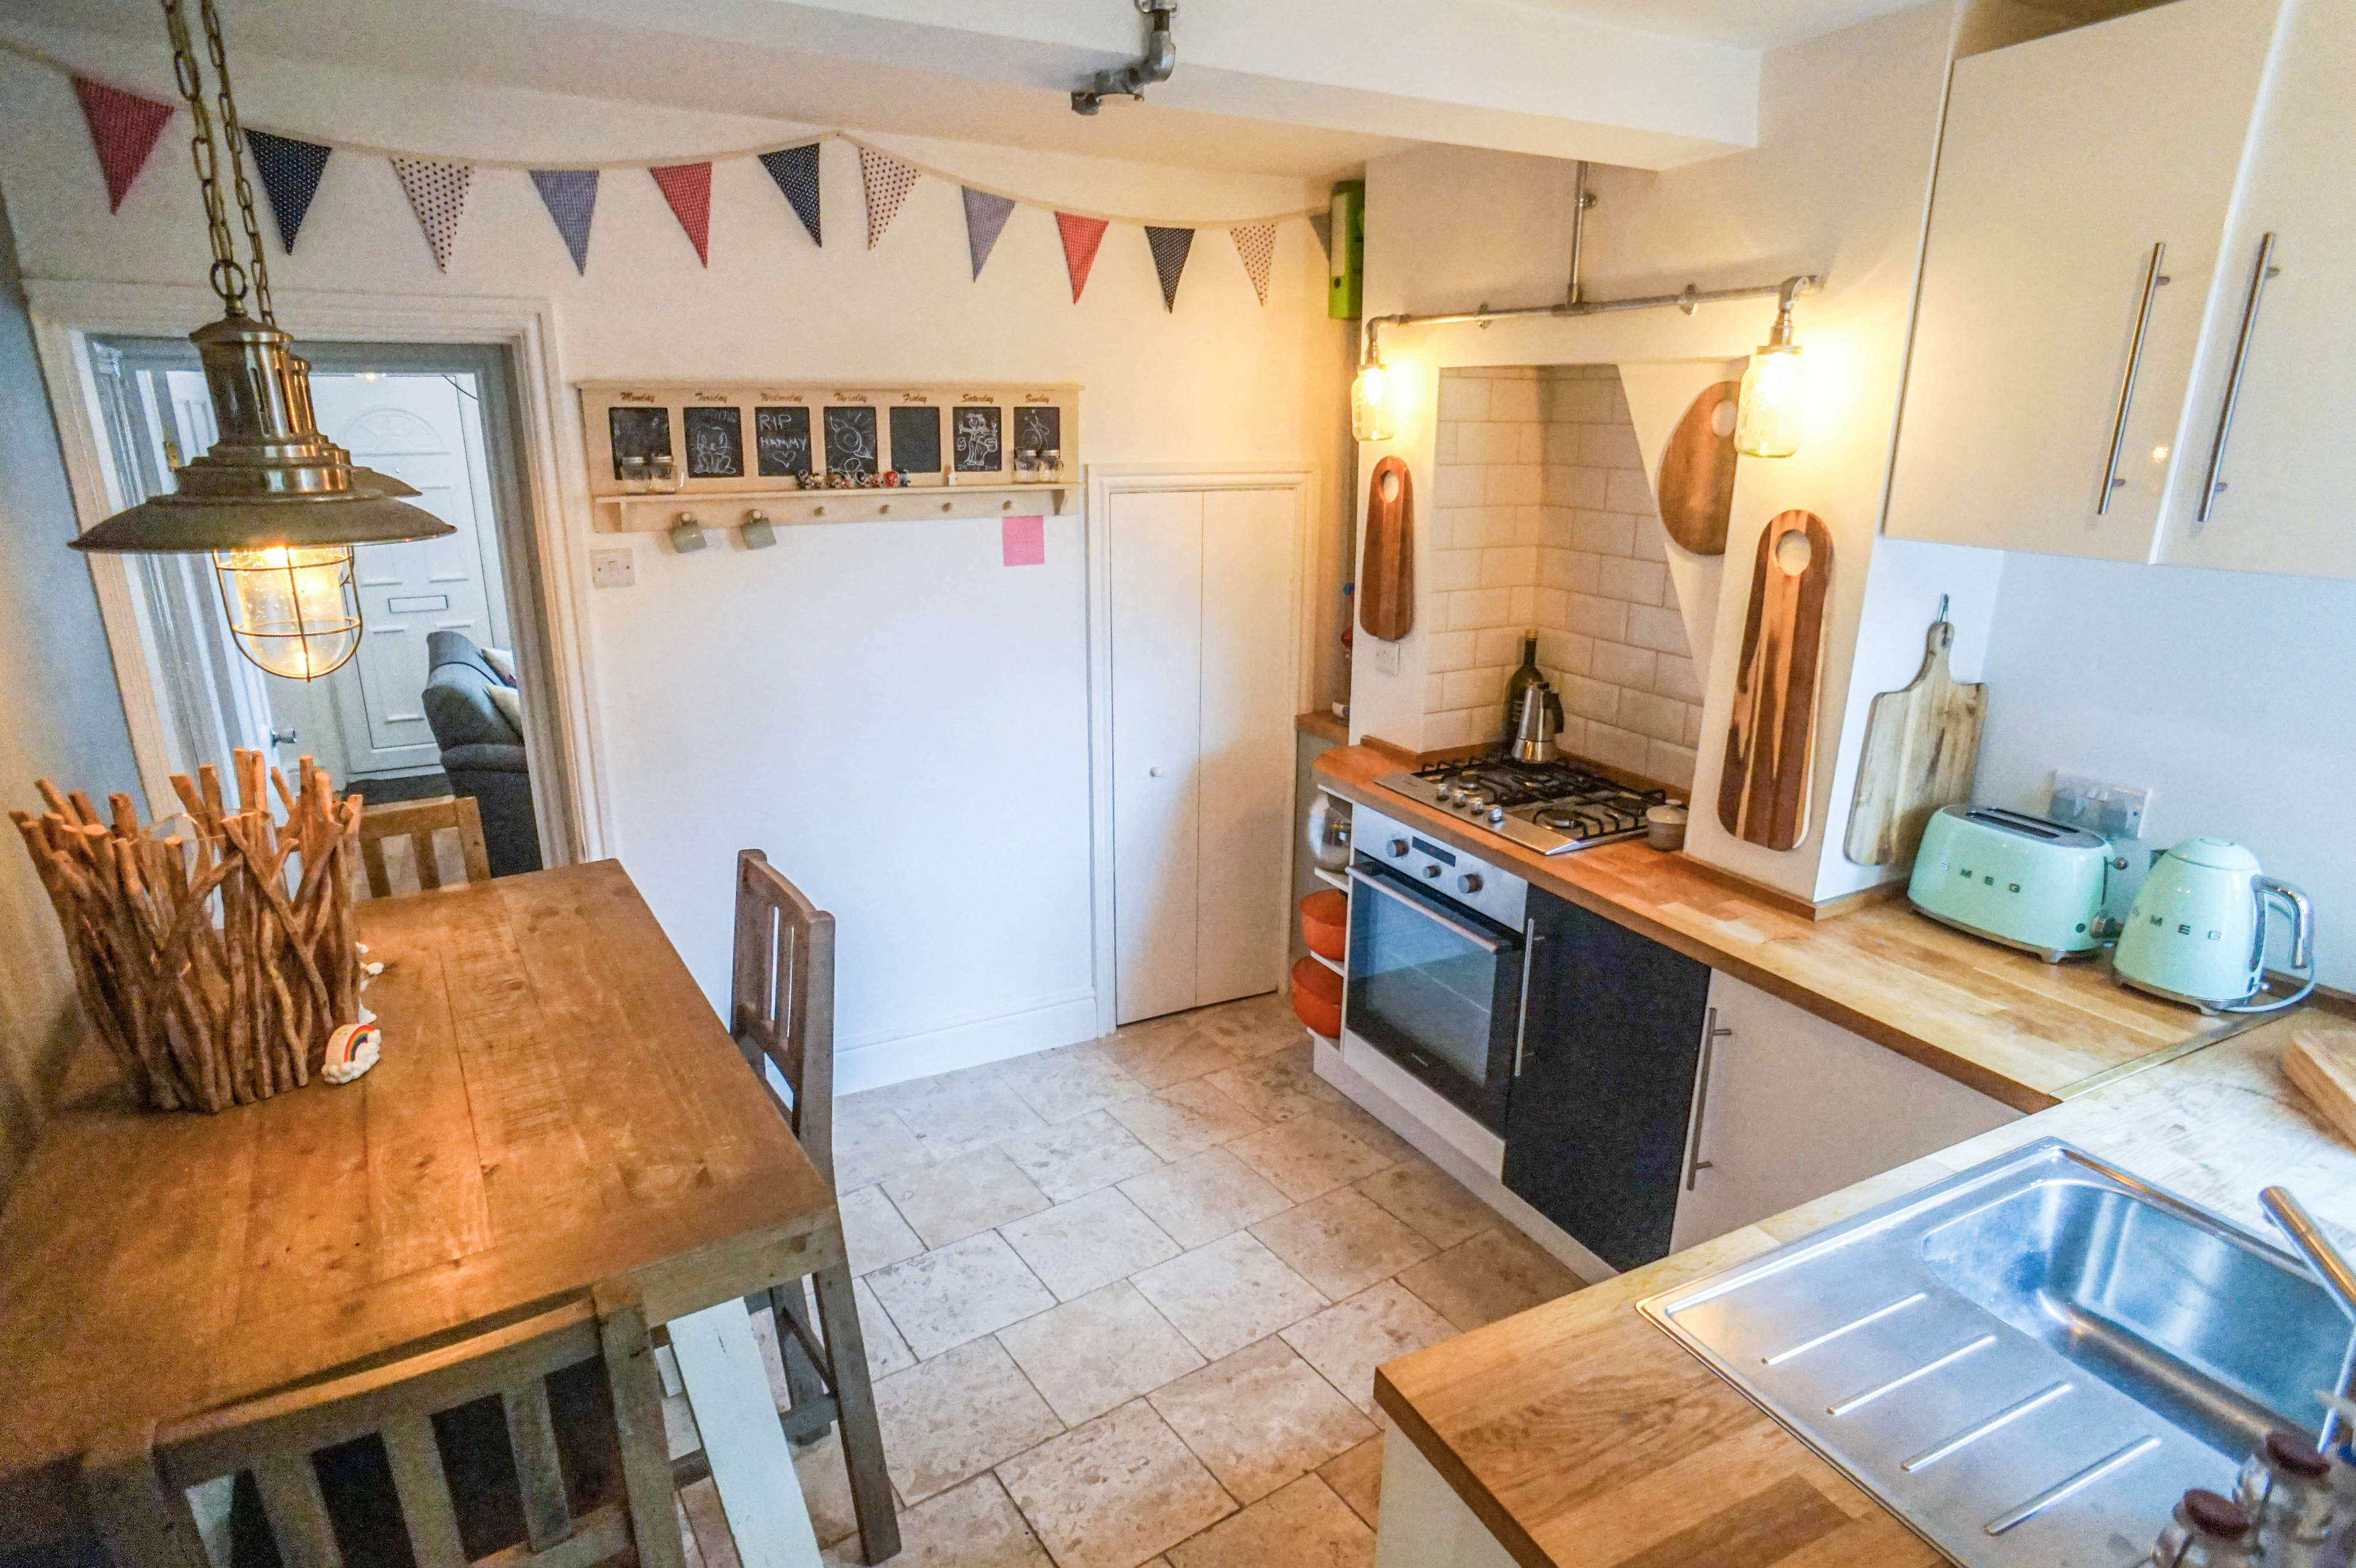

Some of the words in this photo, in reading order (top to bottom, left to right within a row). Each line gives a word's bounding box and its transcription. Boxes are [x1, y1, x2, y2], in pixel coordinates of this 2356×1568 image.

[620, 392, 655, 403] Monday
[695, 393, 728, 403] Tuesday
[903, 393, 928, 404] Friday
[961, 393, 994, 404] Saturday
[1025, 394, 1050, 404] Sunday
[758, 413, 791, 431] RIP
[1939, 861, 2021, 894] SMEG
[2131, 905, 2223, 940] SMEG
